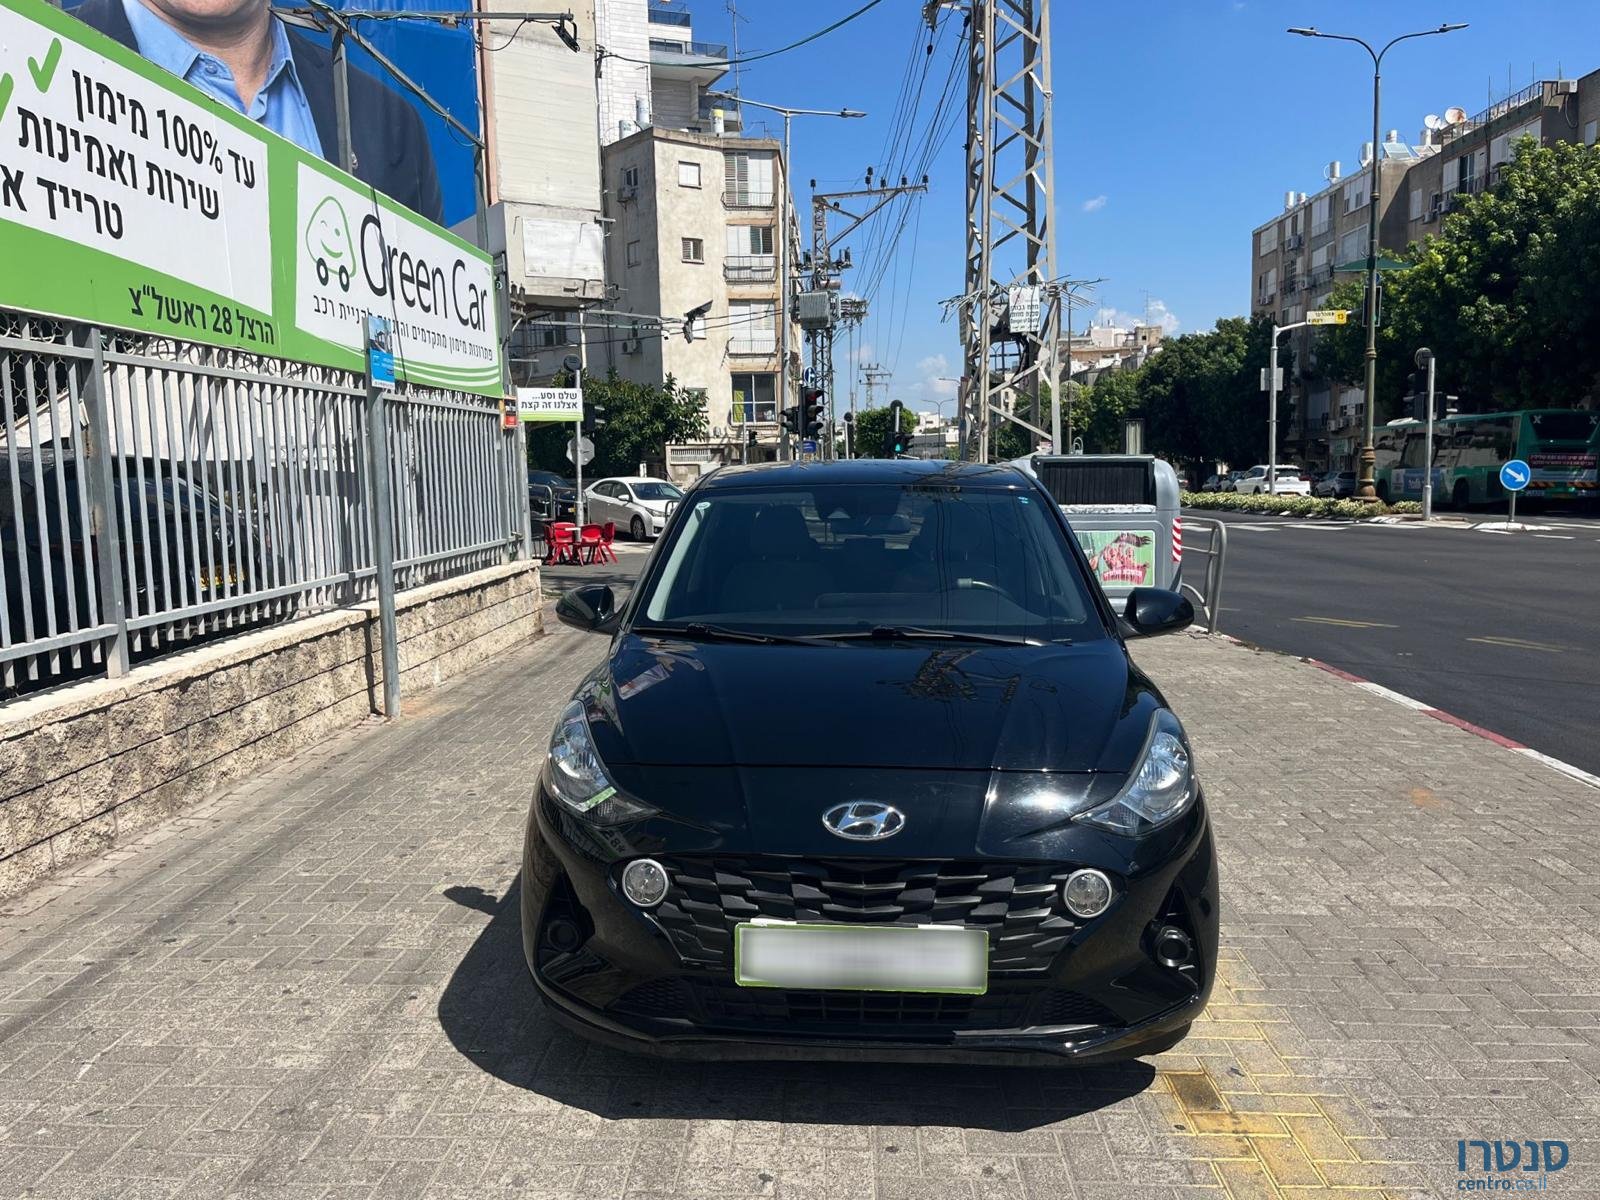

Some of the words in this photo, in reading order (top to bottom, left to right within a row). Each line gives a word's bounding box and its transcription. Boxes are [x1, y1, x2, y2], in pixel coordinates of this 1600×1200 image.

[72, 70, 149, 140] מימון
[17, 106, 138, 190] ואמינות
[157, 109, 223, 174] 100%
[228, 149, 256, 189] עד
[146, 160, 220, 220] שירות
[37, 176, 124, 240] טרייד
[360, 213, 448, 319] Green
[452, 259, 488, 332] Car
[210, 304, 233, 335] 28
[313, 294, 335, 317] רכב
[236, 309, 275, 345] הרצל
[412, 325, 448, 349] מתקדמים
[450, 333, 468, 354] מימון
[469, 341, 493, 361] פתרונות
[521, 401, 539, 410] קצת
[542, 401, 551, 409] זה
[554, 400, 577, 408] אצלנו
[558, 391, 577, 399] שלם
